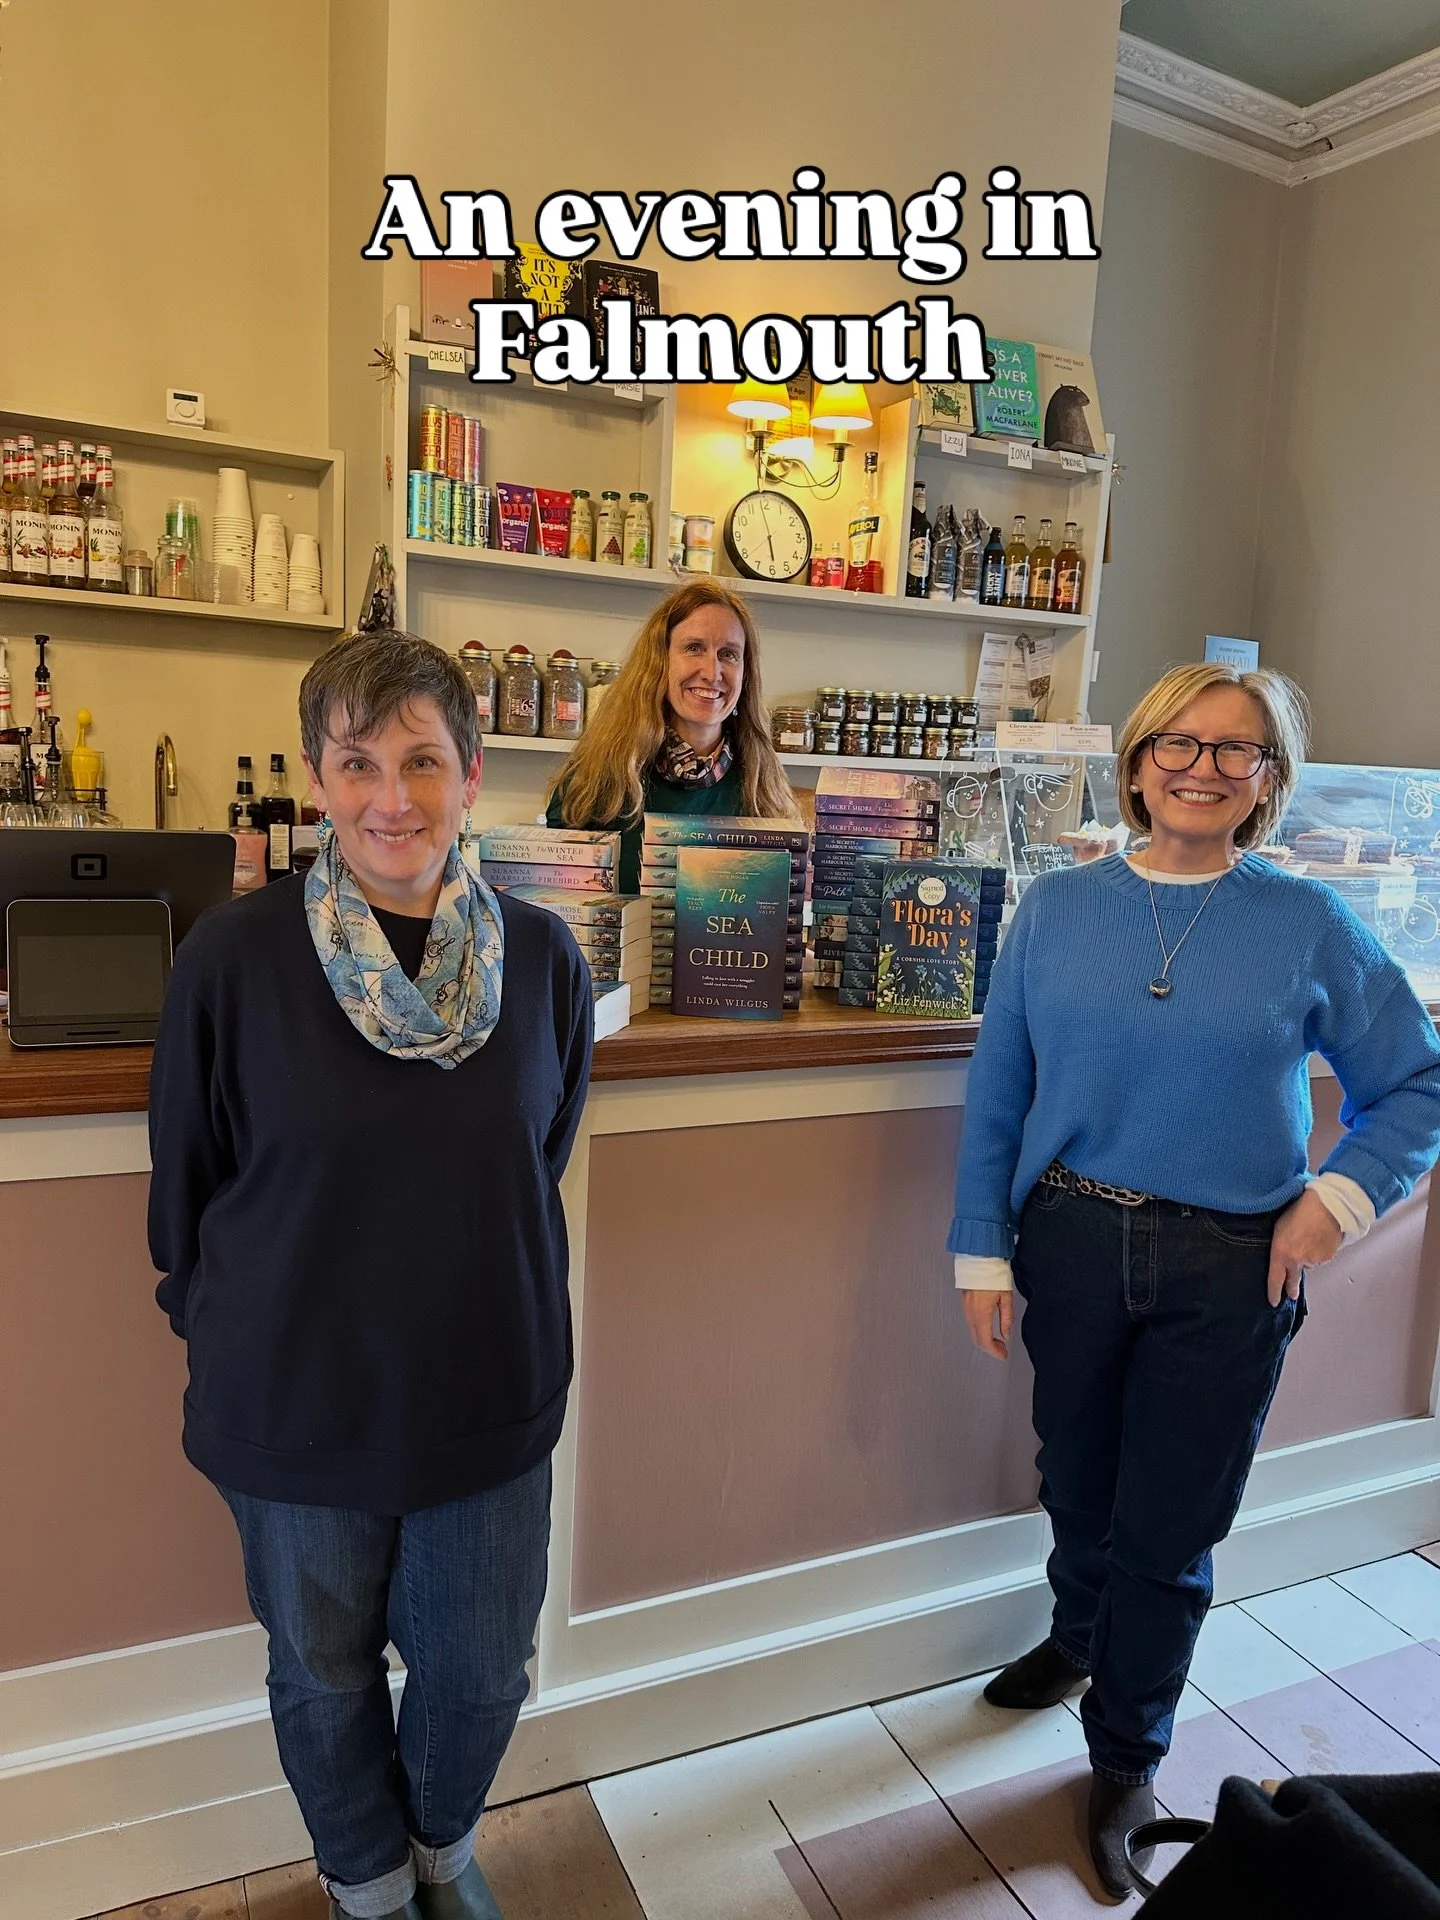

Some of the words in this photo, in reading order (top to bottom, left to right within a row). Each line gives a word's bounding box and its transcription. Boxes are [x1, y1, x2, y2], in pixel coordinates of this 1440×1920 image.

[534, 259, 556, 273] IT'S
[531, 272, 560, 288] NOT
[541, 288, 550, 301] A
[429, 350, 464, 363] CHELSEA
[1011, 352, 1021, 363] A
[615, 383, 641, 393] MAISIE
[988, 386, 1032, 403] ALIVE?
[997, 406, 1026, 417] ROBERT
[986, 416, 1038, 429] MACFARLANE
[944, 434, 964, 453] Izzy
[1010, 446, 1031, 462] IONA
[501, 503, 531, 520] pip
[501, 518, 529, 528] organic
[541, 521, 568, 532] organic
[738, 516, 748, 527] 10
[789, 516, 796, 527] 2
[50, 524, 80, 532] MONIN
[735, 531, 741, 542] 9
[796, 533, 803, 544] 3
[742, 549, 749, 560] 8
[792, 551, 799, 560] 4
[755, 561, 761, 571] 7
[769, 565, 776, 576] 6
[784, 561, 790, 572] 5
[986, 571, 995, 596] LUCKY
[994, 572, 1002, 597] SAINT
[690, 832, 713, 841] SEA
[716, 833, 757, 845] CHILD
[491, 843, 530, 852] SUSANNA
[547, 846, 584, 855] WINTER
[489, 851, 532, 859] KEARSLEY
[557, 854, 574, 862] SEA
[492, 868, 531, 876] SUSANNA
[490, 875, 533, 883] KEARSLEY
[538, 876, 580, 885] FIREBIRD
[824, 886, 847, 897] Path
[920, 885, 944, 894] Signed
[719, 888, 746, 904] The
[923, 893, 941, 901] Copy
[560, 905, 582, 914] ROSE
[891, 899, 972, 927] Flora's
[706, 916, 754, 936] SEA
[906, 923, 953, 956] Day
[689, 948, 769, 969] CHILD
[686, 996, 721, 1006] LINDA
[725, 998, 770, 1009] WILGUS
[894, 994, 910, 1006] Liz
[913, 995, 958, 1010] Fenwick
